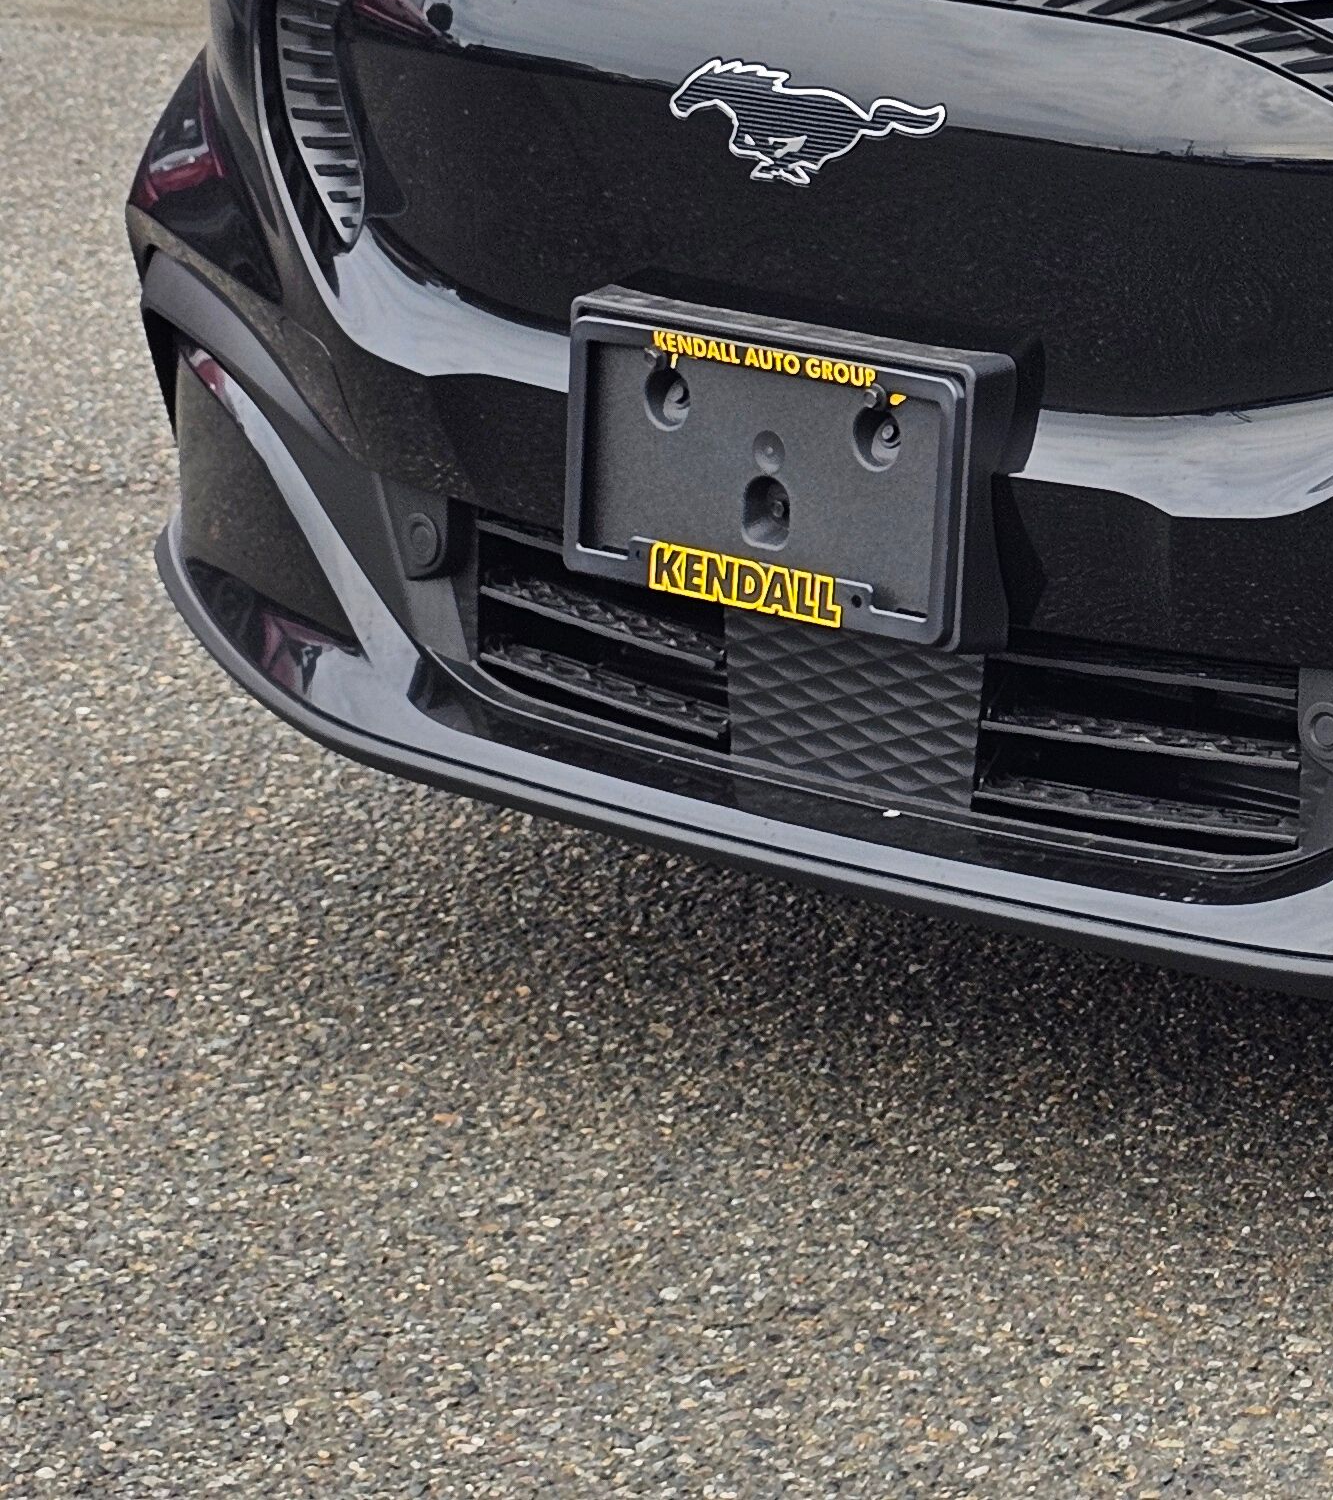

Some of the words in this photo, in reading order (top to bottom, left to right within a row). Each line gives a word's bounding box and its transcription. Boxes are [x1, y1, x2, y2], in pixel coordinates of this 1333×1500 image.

[652, 330, 741, 365] KENDALL
[744, 347, 801, 376] AUTO
[805, 356, 877, 388] GROUP
[650, 541, 842, 629] KENDALL
